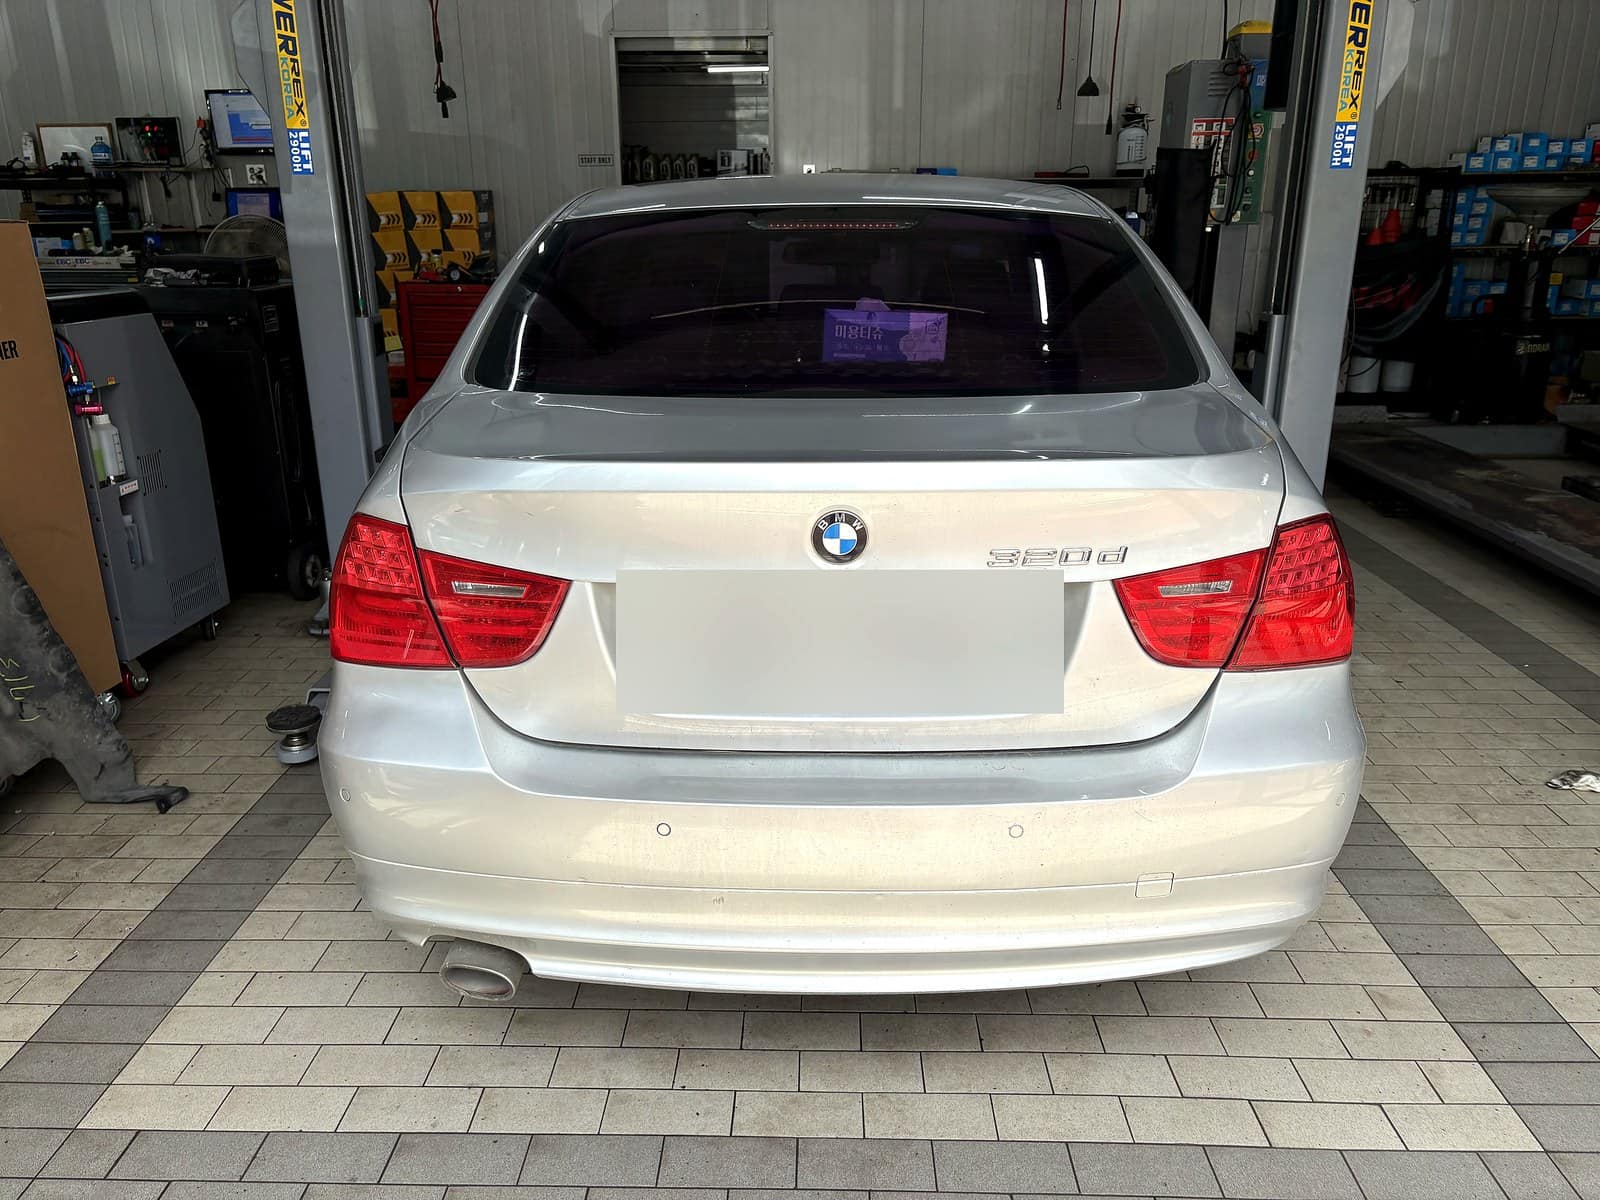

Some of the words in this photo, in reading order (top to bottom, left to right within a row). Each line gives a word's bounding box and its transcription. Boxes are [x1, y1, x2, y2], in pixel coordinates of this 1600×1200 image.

[280, 57, 295, 118] KOREA
[1339, 49, 1355, 112] KOREA
[288, 131, 303, 172] 2900H
[299, 131, 313, 173] LIFT
[1331, 124, 1346, 166] 2900H
[1342, 124, 1357, 167] LIFT
[817, 512, 864, 531] BMW
[986, 545, 1129, 568] 320d
